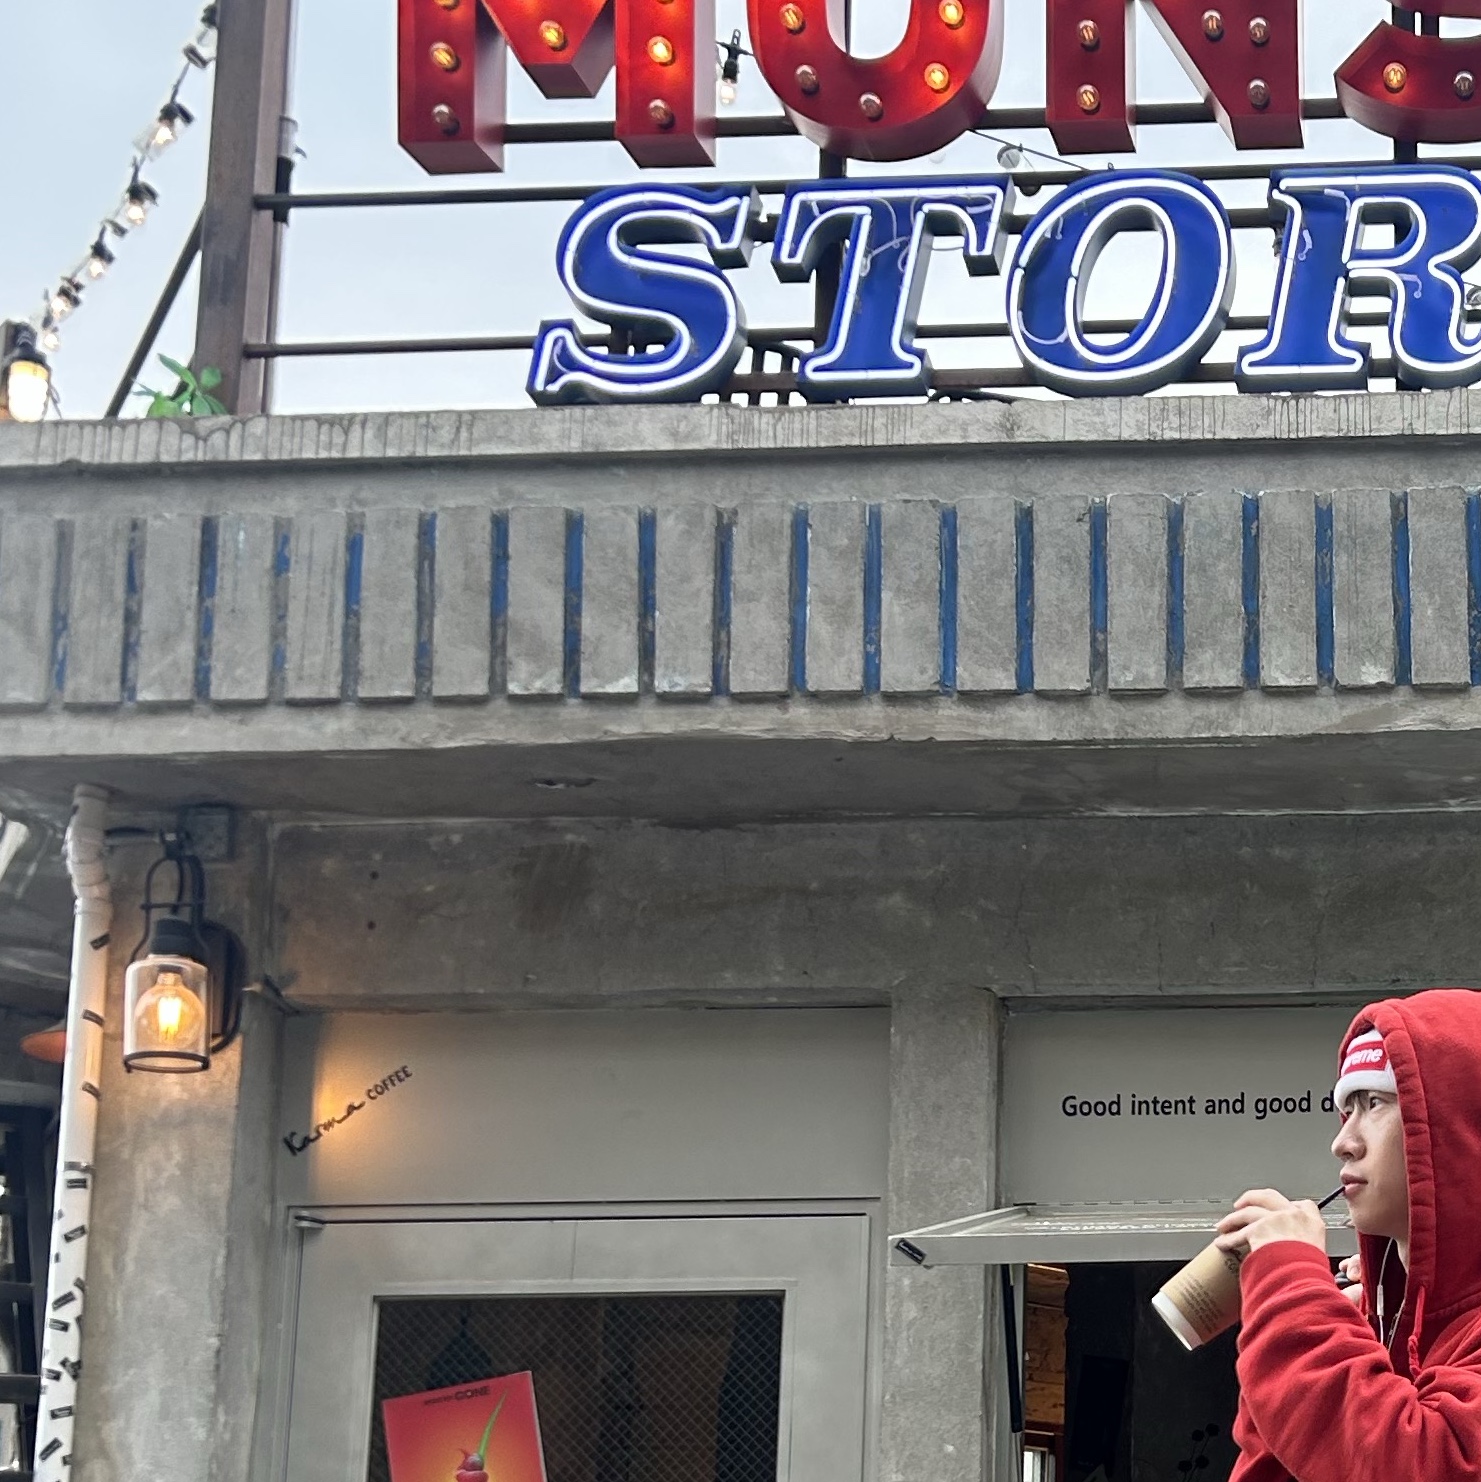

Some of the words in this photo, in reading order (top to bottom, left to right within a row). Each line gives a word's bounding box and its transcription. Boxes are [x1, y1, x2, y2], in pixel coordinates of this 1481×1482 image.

[283, 1101, 365, 1156] Karma
[366, 1065, 413, 1101] COFFEE
[1061, 1093, 1122, 1117] Good
[1131, 1093, 1196, 1116] intent
[1204, 1092, 1246, 1115] and
[1254, 1090, 1312, 1120] good
